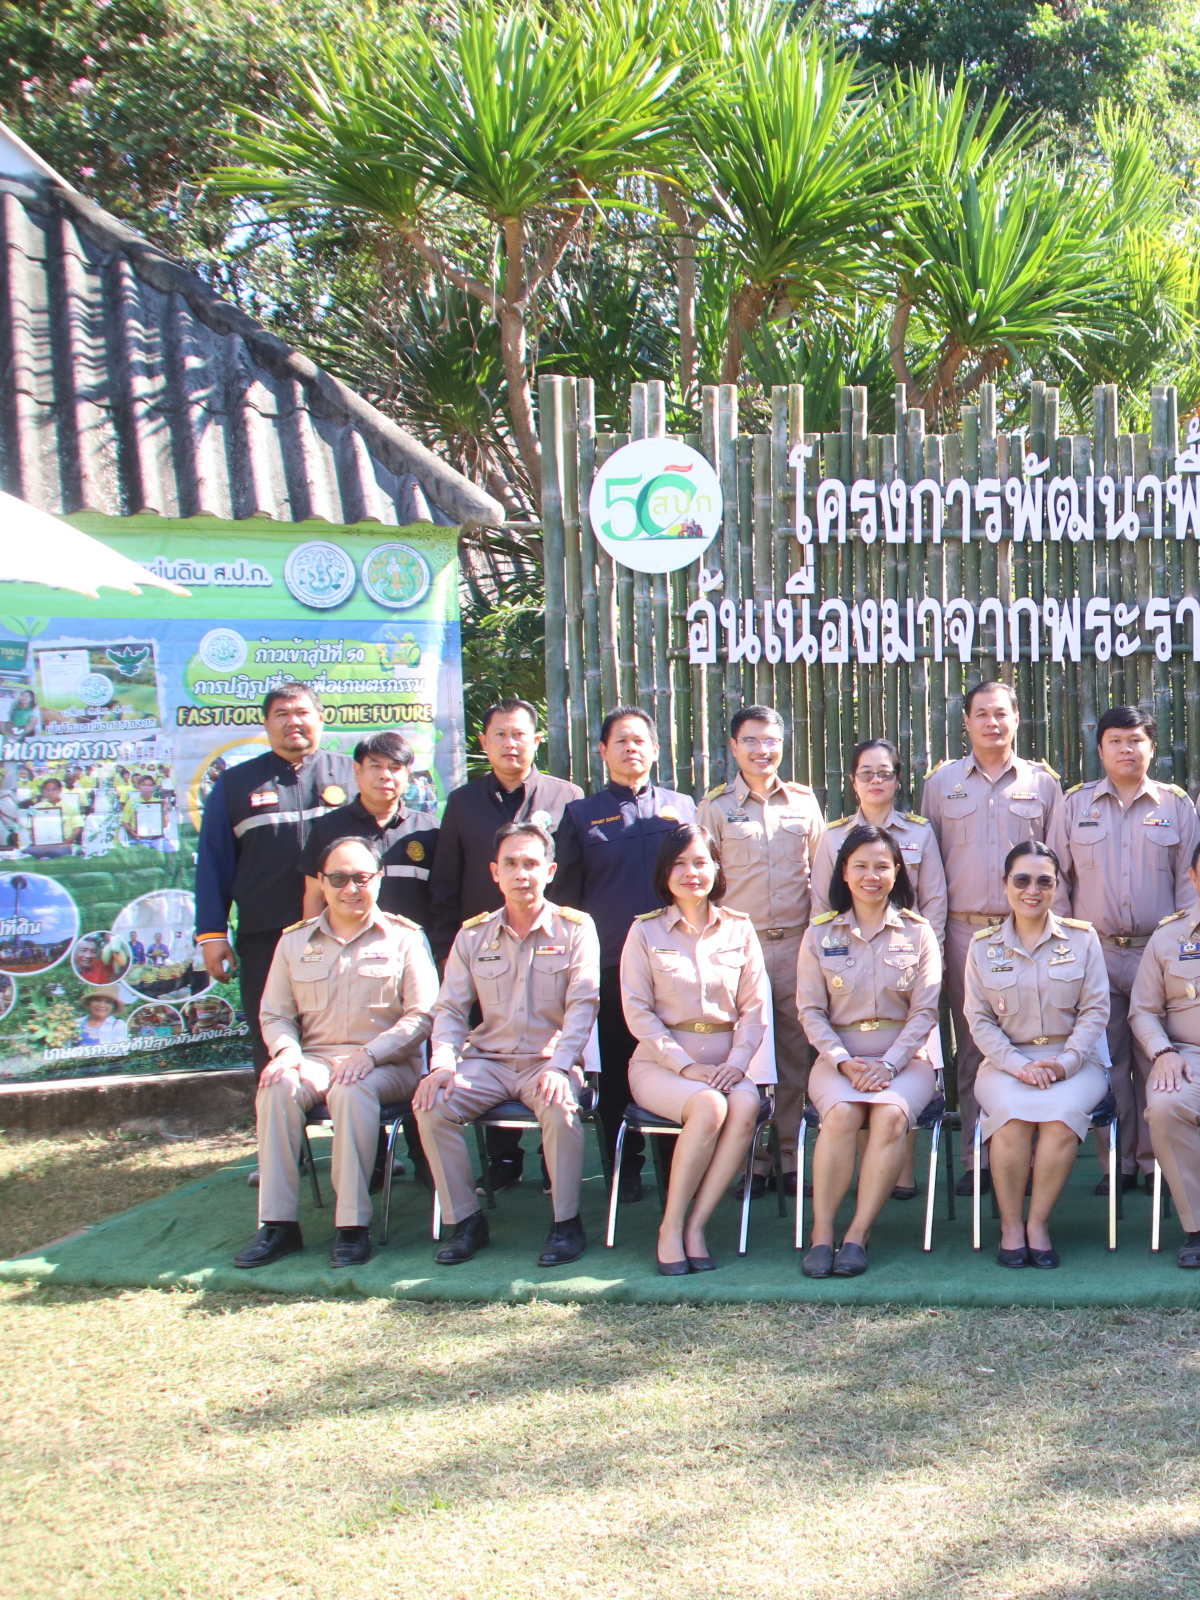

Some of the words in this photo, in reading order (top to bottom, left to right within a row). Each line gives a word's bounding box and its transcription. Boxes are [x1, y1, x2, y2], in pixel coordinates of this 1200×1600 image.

[142, 559, 206, 581] ผ่นดิน
[213, 561, 269, 581] ส.ป.ก.
[255, 637, 345, 669] ก้าวเข้าสู่ปีที่
[346, 648, 366, 663] 50
[177, 706, 223, 727] FAST
[340, 705, 370, 723] THE
[372, 704, 433, 723] FUTURE
[0, 727, 121, 761] ห้เกษตรกร
